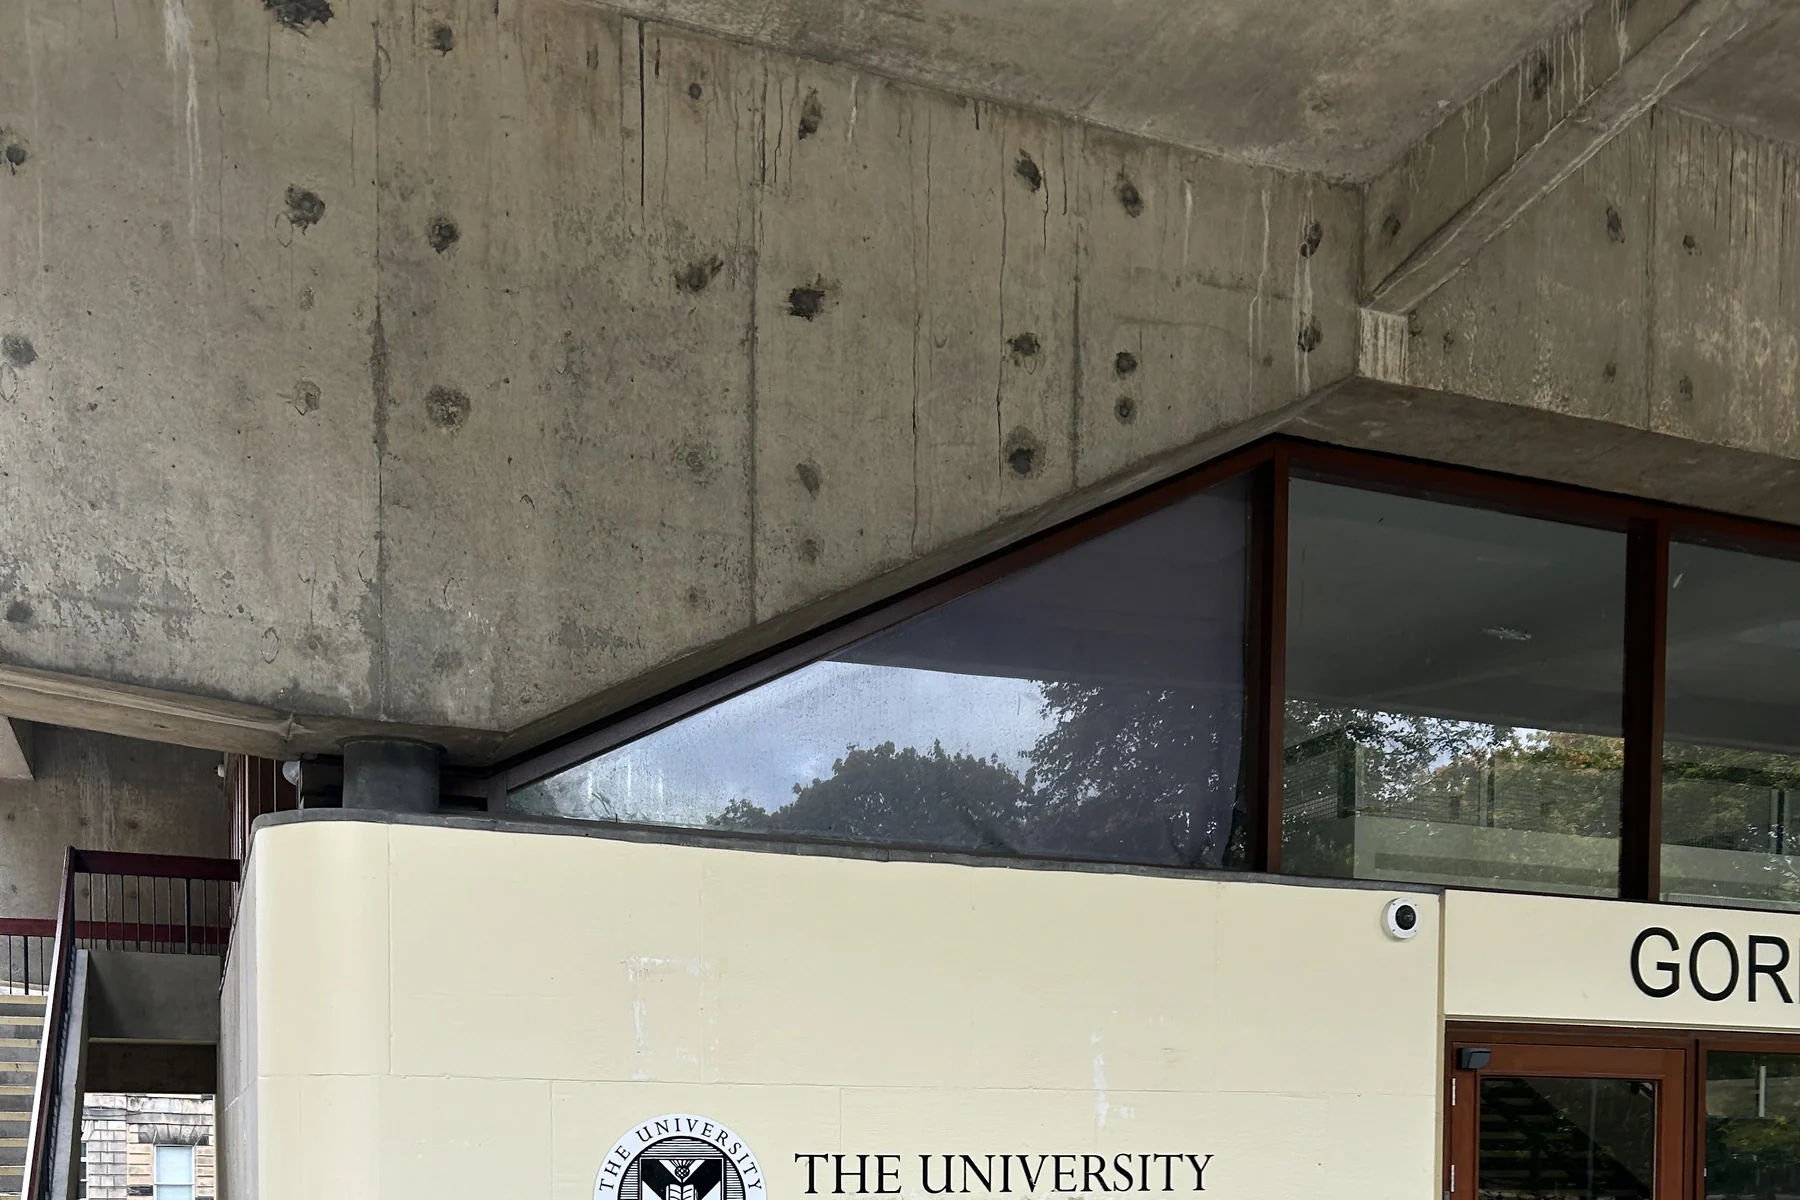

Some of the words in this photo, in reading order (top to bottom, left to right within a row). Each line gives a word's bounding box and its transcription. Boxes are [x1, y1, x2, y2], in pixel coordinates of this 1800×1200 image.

[1630, 926, 1800, 1004] GOR
[599, 1145, 631, 1192] THE
[635, 1118, 762, 1191] UNIVERSITY
[794, 1153, 902, 1194] THE
[919, 1152, 1214, 1194] UNIVERSITY
